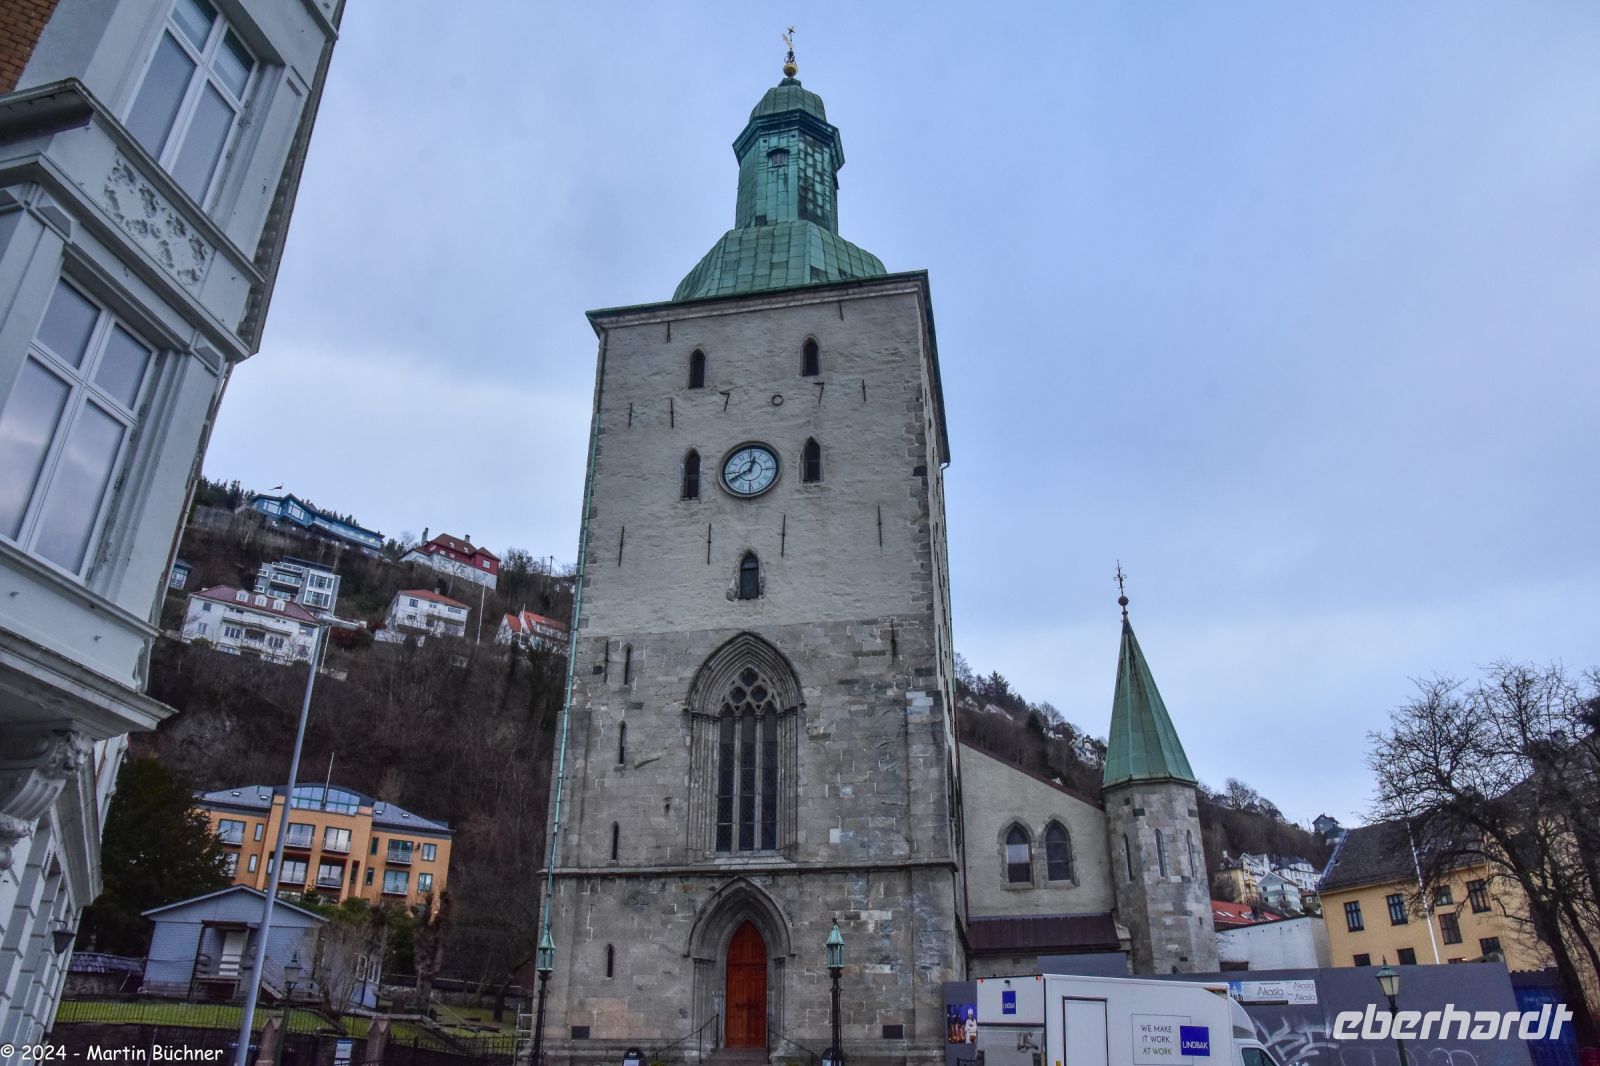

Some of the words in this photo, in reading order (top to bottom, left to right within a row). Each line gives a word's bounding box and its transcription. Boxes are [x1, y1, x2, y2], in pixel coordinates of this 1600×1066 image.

[1258, 986, 1284, 997] Akasia
[1141, 1025, 1152, 1033] WE
[1153, 1025, 1173, 1034] MAKE
[1142, 1035, 1149, 1044] IT
[1182, 1040, 1209, 1050] LINDBAK
[1142, 1047, 1151, 1056] AT
[1152, 1047, 1173, 1056] WORK
